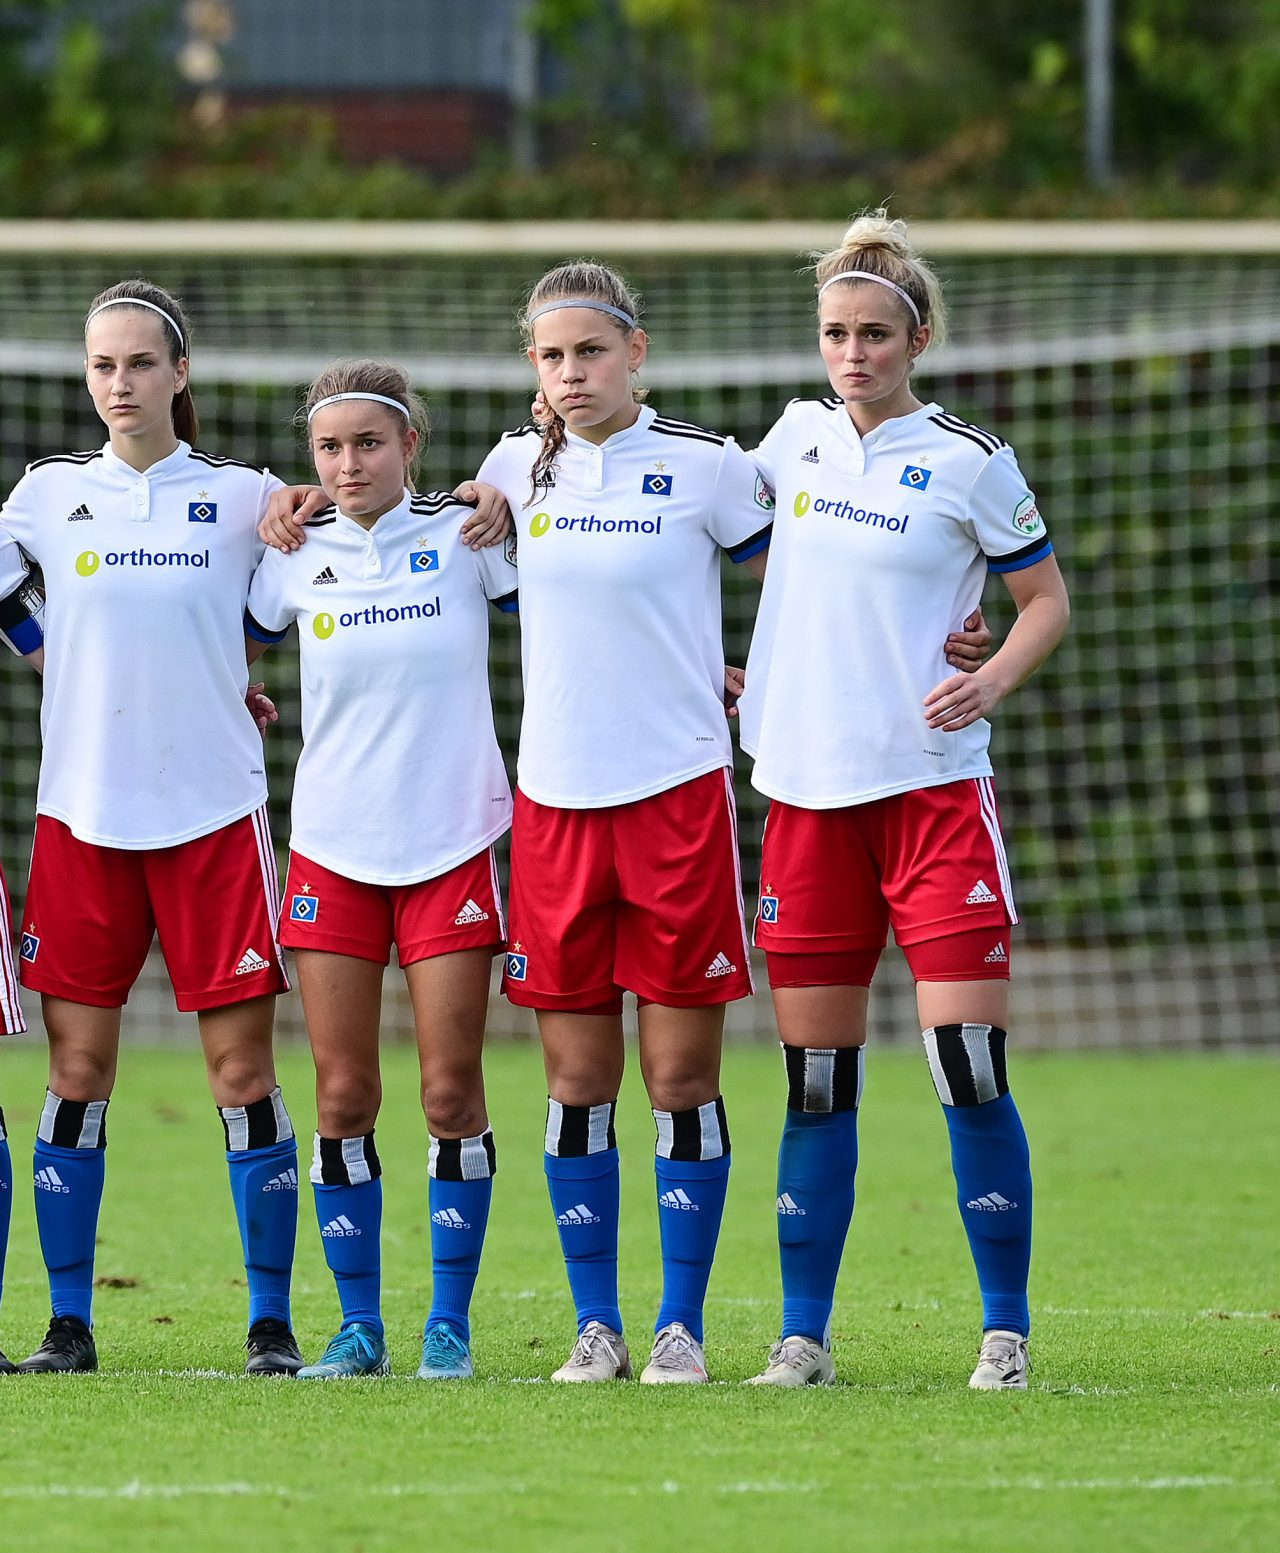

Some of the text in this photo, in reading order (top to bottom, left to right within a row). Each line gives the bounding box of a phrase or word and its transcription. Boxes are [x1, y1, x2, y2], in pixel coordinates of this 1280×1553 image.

[67, 514, 93, 522] adidas
[813, 497, 909, 534] orthomol
[555, 514, 661, 534] orthomol
[104, 549, 209, 569] orthomol
[312, 577, 338, 585] adidas
[338, 596, 441, 627] orthomol
[966, 893, 997, 904] adidas
[454, 912, 489, 925] adidas
[235, 960, 270, 975] adidas
[705, 965, 736, 978] adidas
[659, 1198, 699, 1211] adidas
[967, 1202, 1018, 1212] adidas
[431, 1215, 471, 1230] adidas
[556, 1216, 600, 1226] adidas
[321, 1228, 361, 1237] adidas
